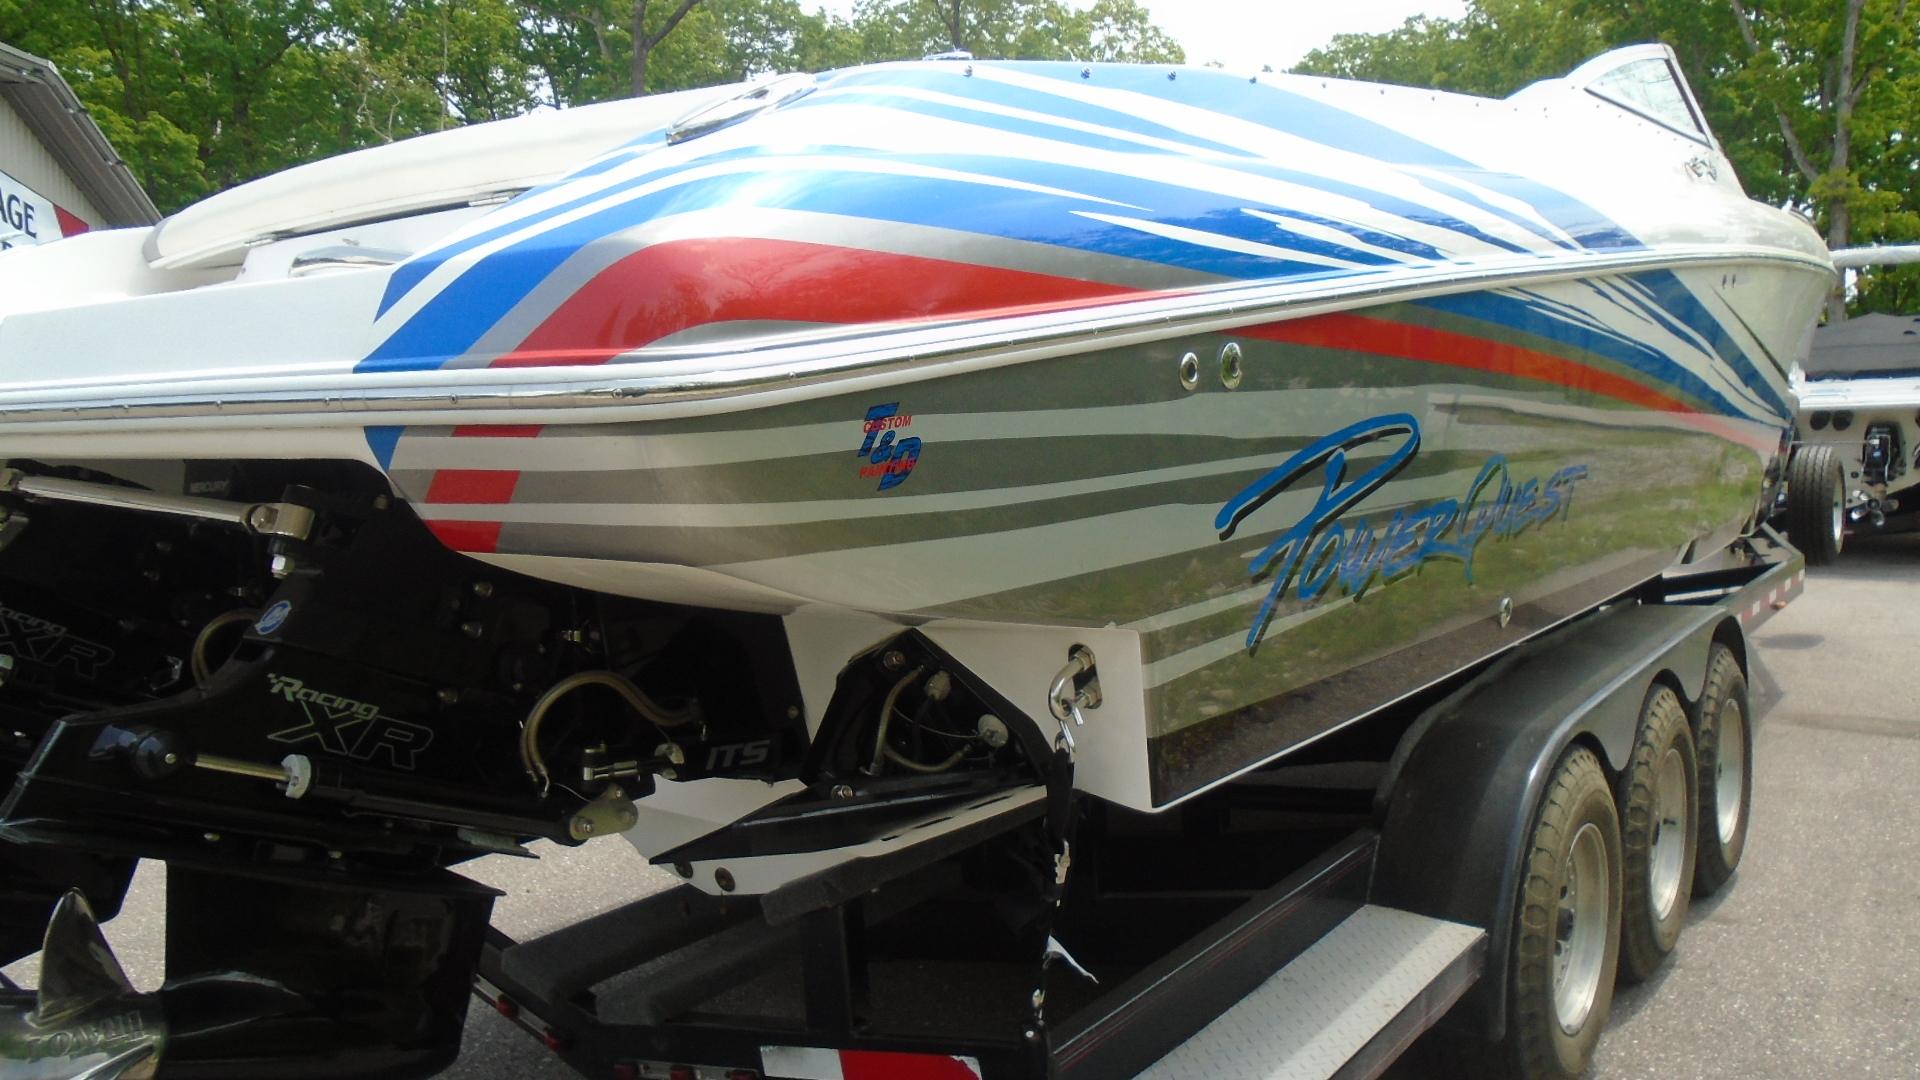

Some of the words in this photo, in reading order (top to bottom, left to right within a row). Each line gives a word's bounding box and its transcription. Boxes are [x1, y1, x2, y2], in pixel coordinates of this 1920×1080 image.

[863, 414, 913, 433] CUSTOM
[267, 672, 379, 720] Racing
[267, 699, 434, 771] XR
[705, 740, 771, 770] ITS
